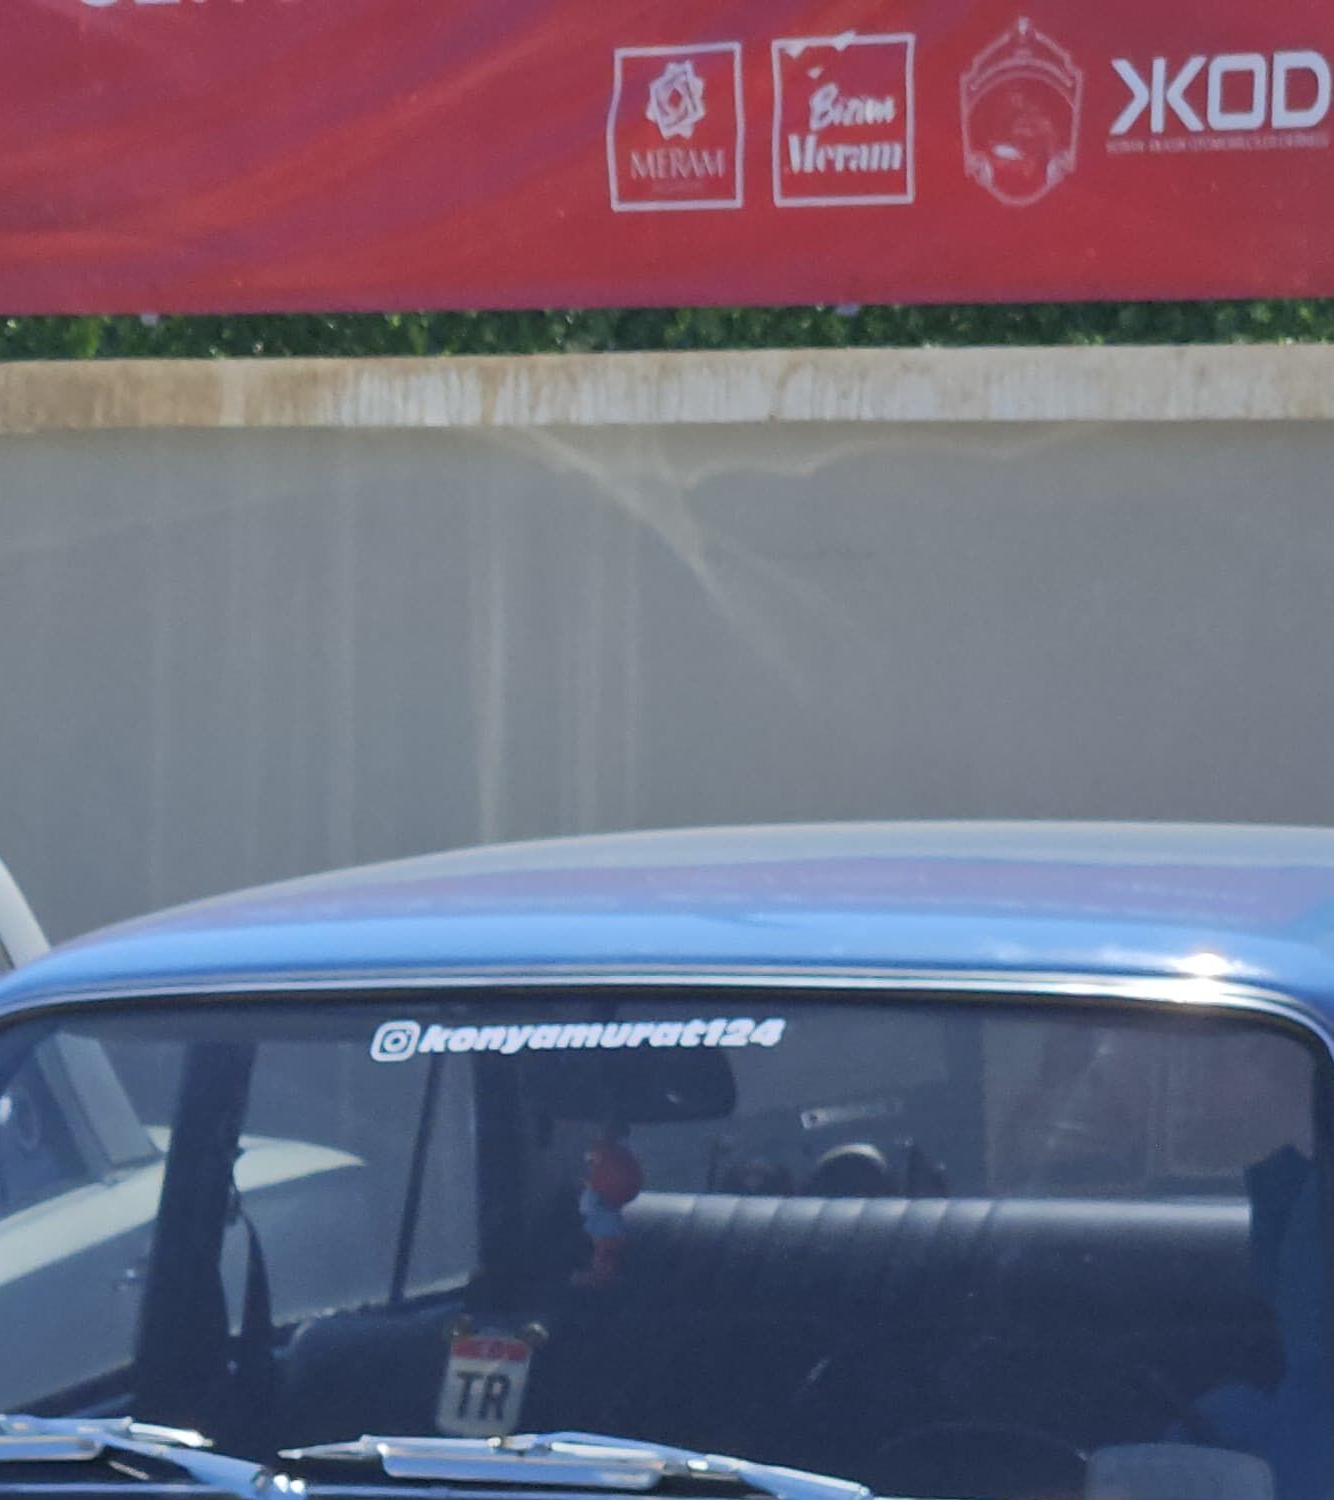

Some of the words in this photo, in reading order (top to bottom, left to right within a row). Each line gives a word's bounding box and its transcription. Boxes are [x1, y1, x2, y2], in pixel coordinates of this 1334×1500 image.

[630, 149, 725, 179] MERAM
[419, 1019, 786, 1054] konyamurat124
[456, 1371, 511, 1420] TR
